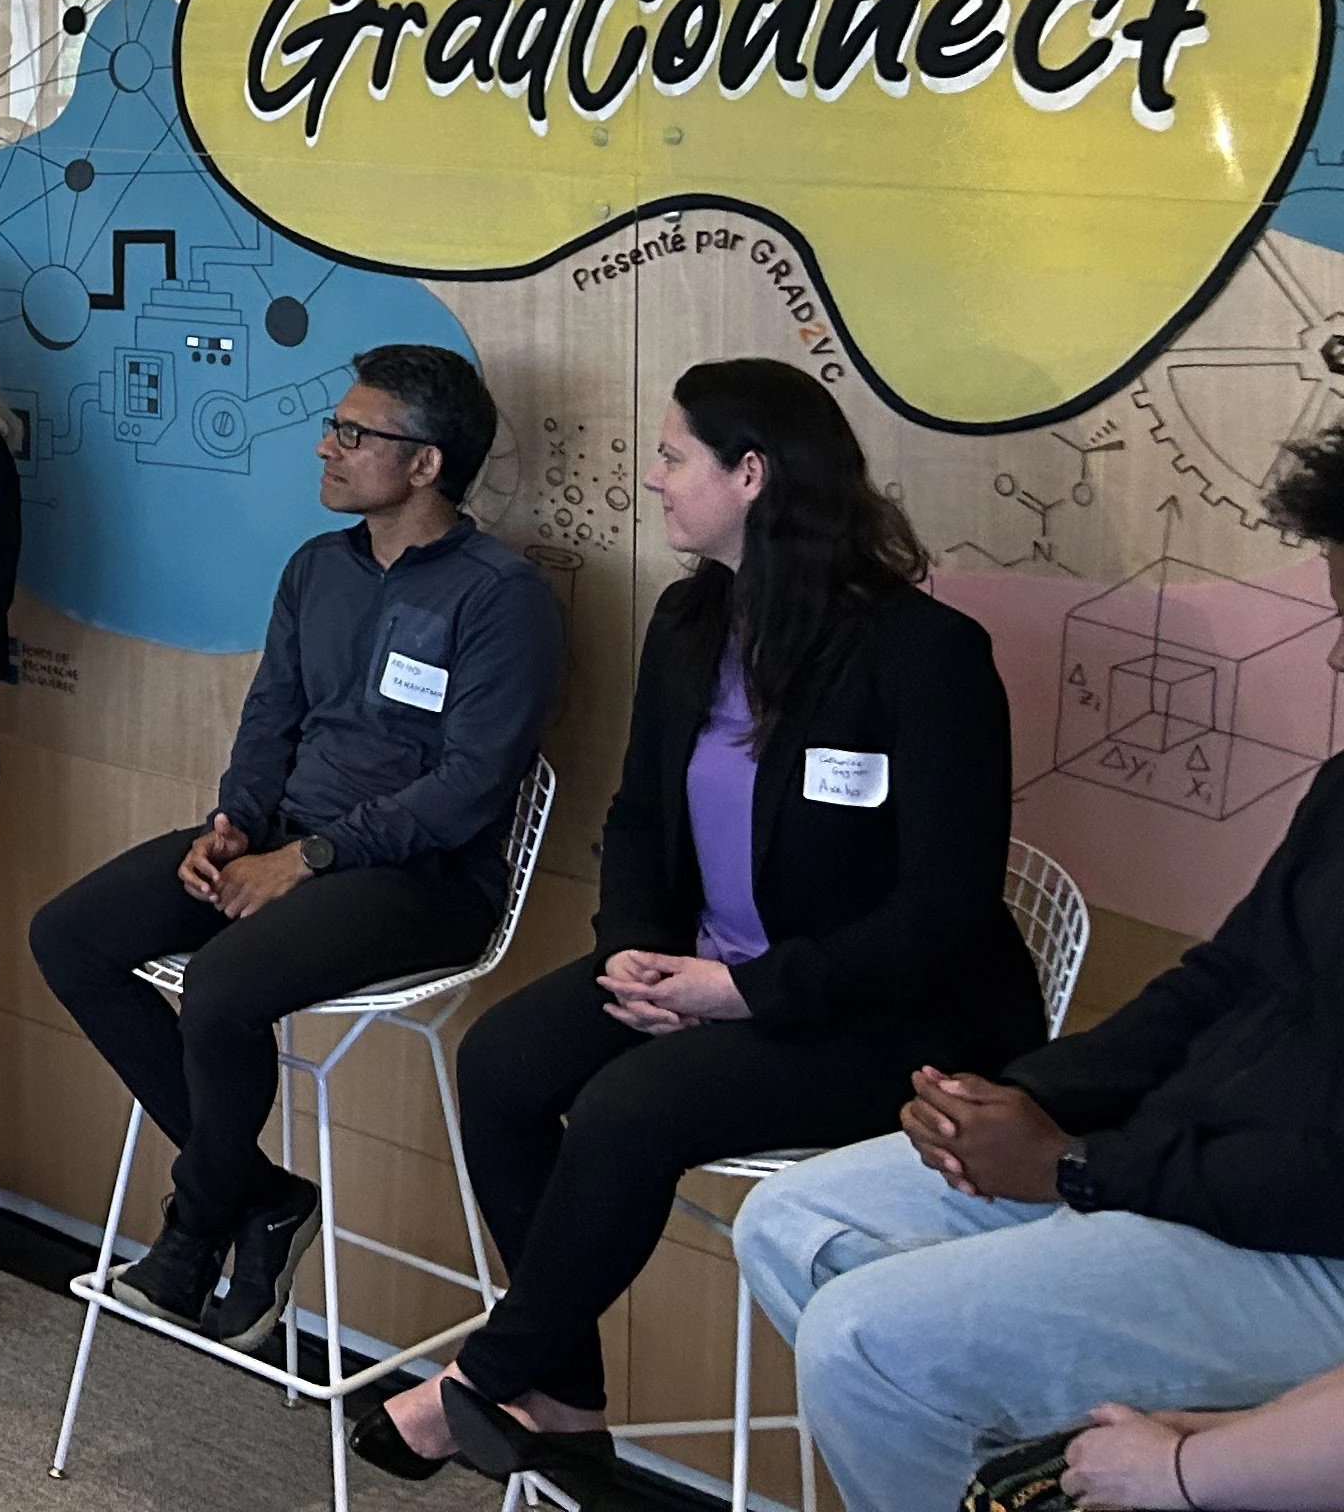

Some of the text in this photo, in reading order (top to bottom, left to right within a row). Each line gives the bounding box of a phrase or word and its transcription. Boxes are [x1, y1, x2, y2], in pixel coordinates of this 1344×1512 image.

[572, 223, 845, 384] Présenté par GRAD2VC
[1032, 540, 1052, 562] N
